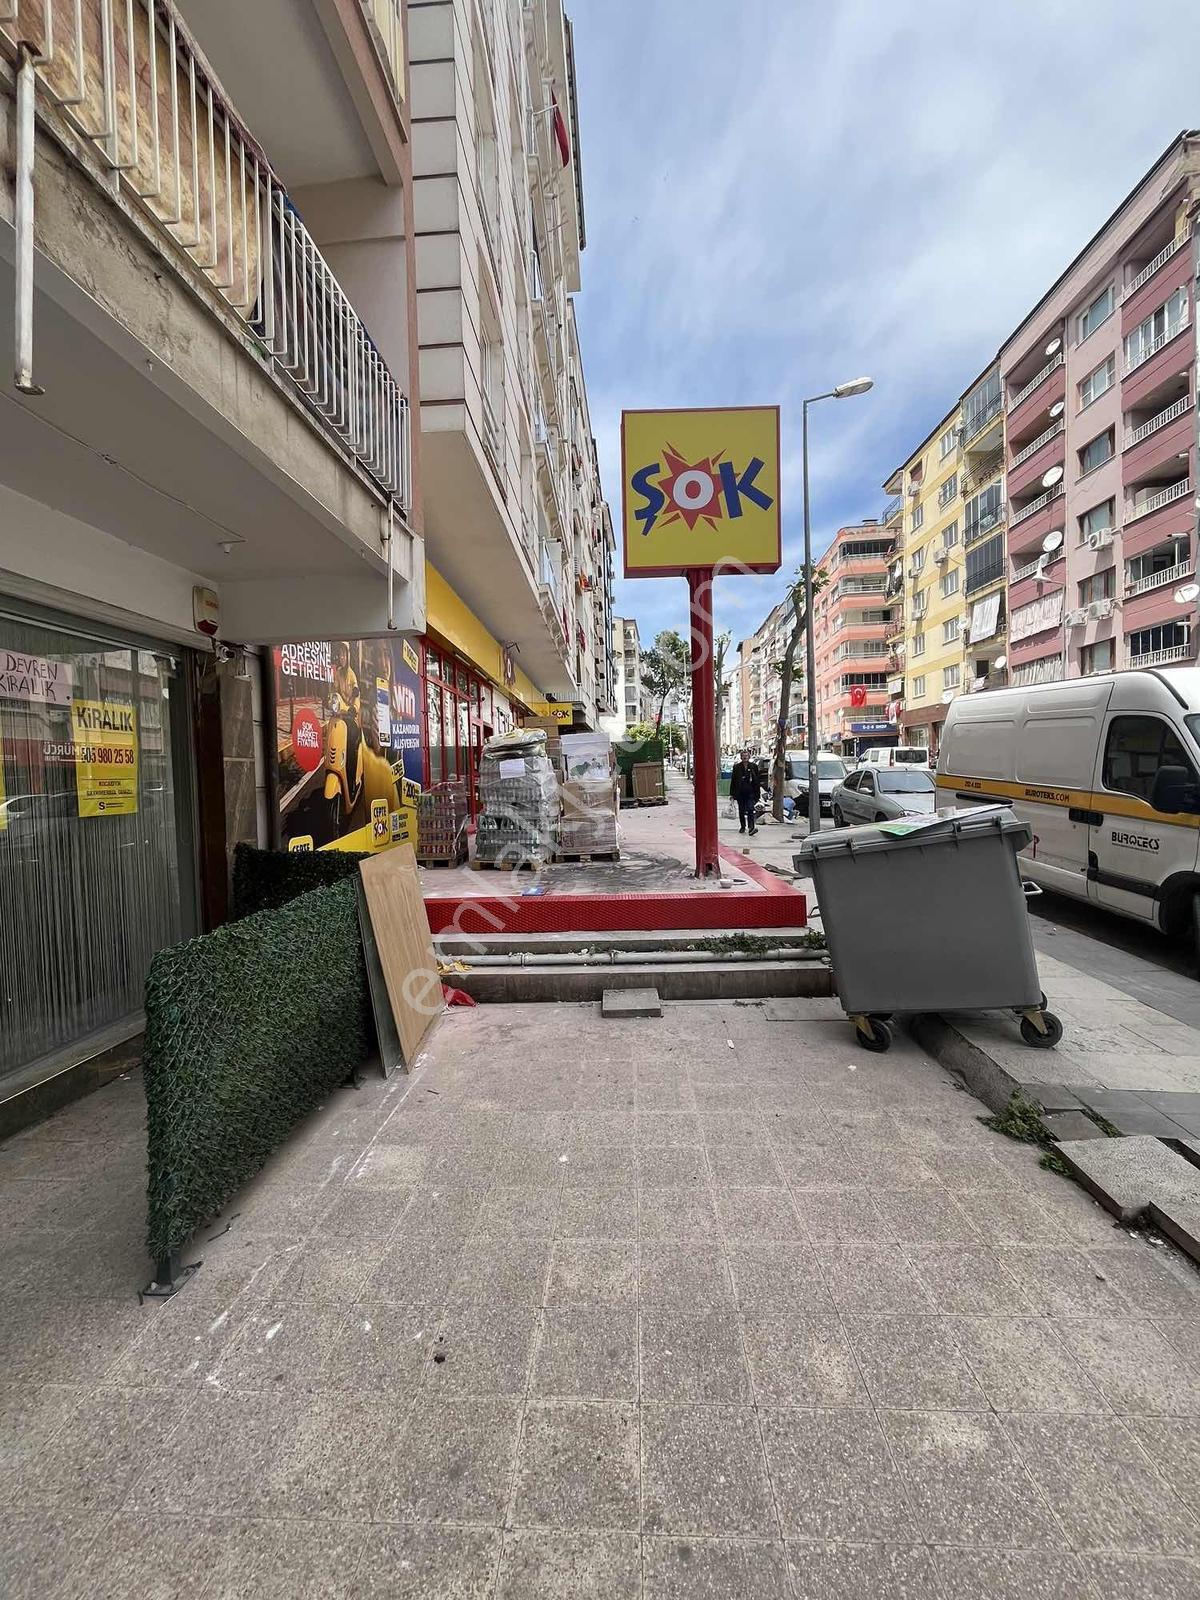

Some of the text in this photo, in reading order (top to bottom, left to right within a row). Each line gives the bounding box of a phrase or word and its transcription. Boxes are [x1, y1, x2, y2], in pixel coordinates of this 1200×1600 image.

[631, 456, 774, 536] ŞOK
[6, 653, 58, 680] DEVREN
[97, 748, 113, 764] 980
[113, 748, 124, 764] 25
[124, 749, 134, 764] 58
